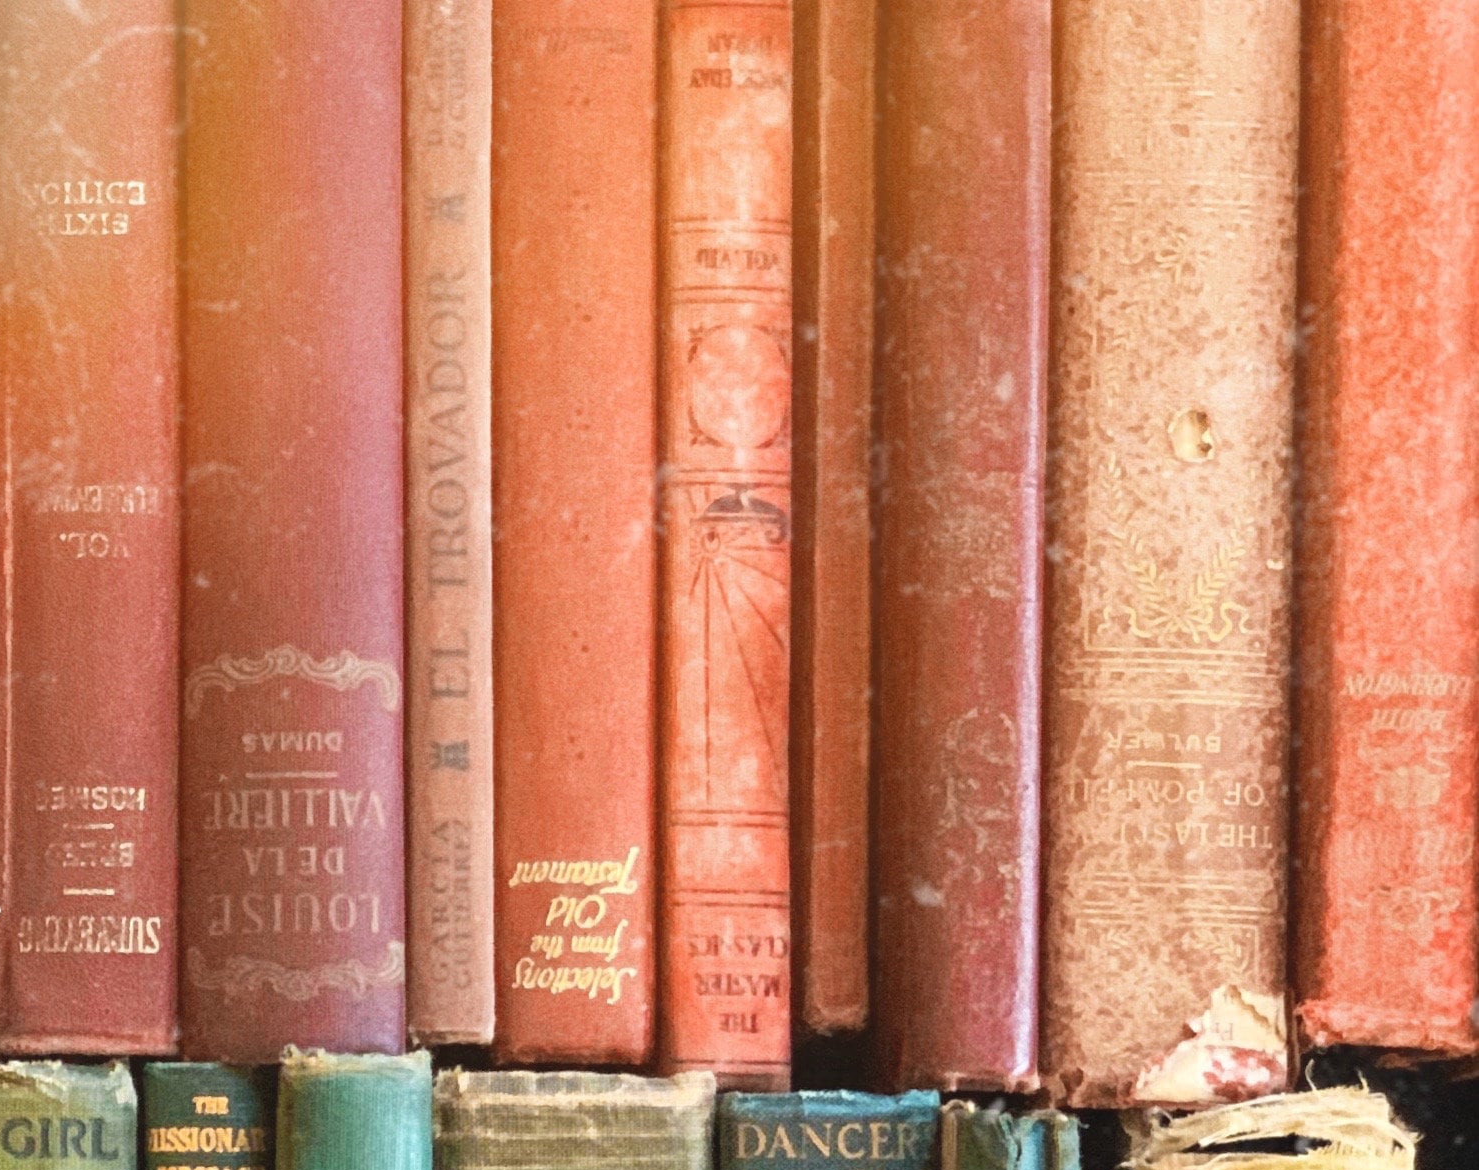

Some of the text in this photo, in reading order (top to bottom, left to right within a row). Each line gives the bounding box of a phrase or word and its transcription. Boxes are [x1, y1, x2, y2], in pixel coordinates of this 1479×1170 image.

[427, 267, 471, 700] EL TROVADOR
[241, 731, 345, 753] DUMAS
[1223, 781, 1266, 807] OF
[1218, 823, 1274, 849] THE
[242, 846, 346, 876] DE LA
[508, 846, 640, 897] Testament
[207, 893, 382, 936] LOUISE
[545, 895, 608, 929] Old
[529, 919, 629, 963] from the
[511, 958, 638, 1006] Selections
[695, 973, 784, 998] MASTER
[192, 1096, 229, 1115] THE
[0, 1115, 120, 1160] GIRL
[735, 1123, 931, 1160] DANCER
